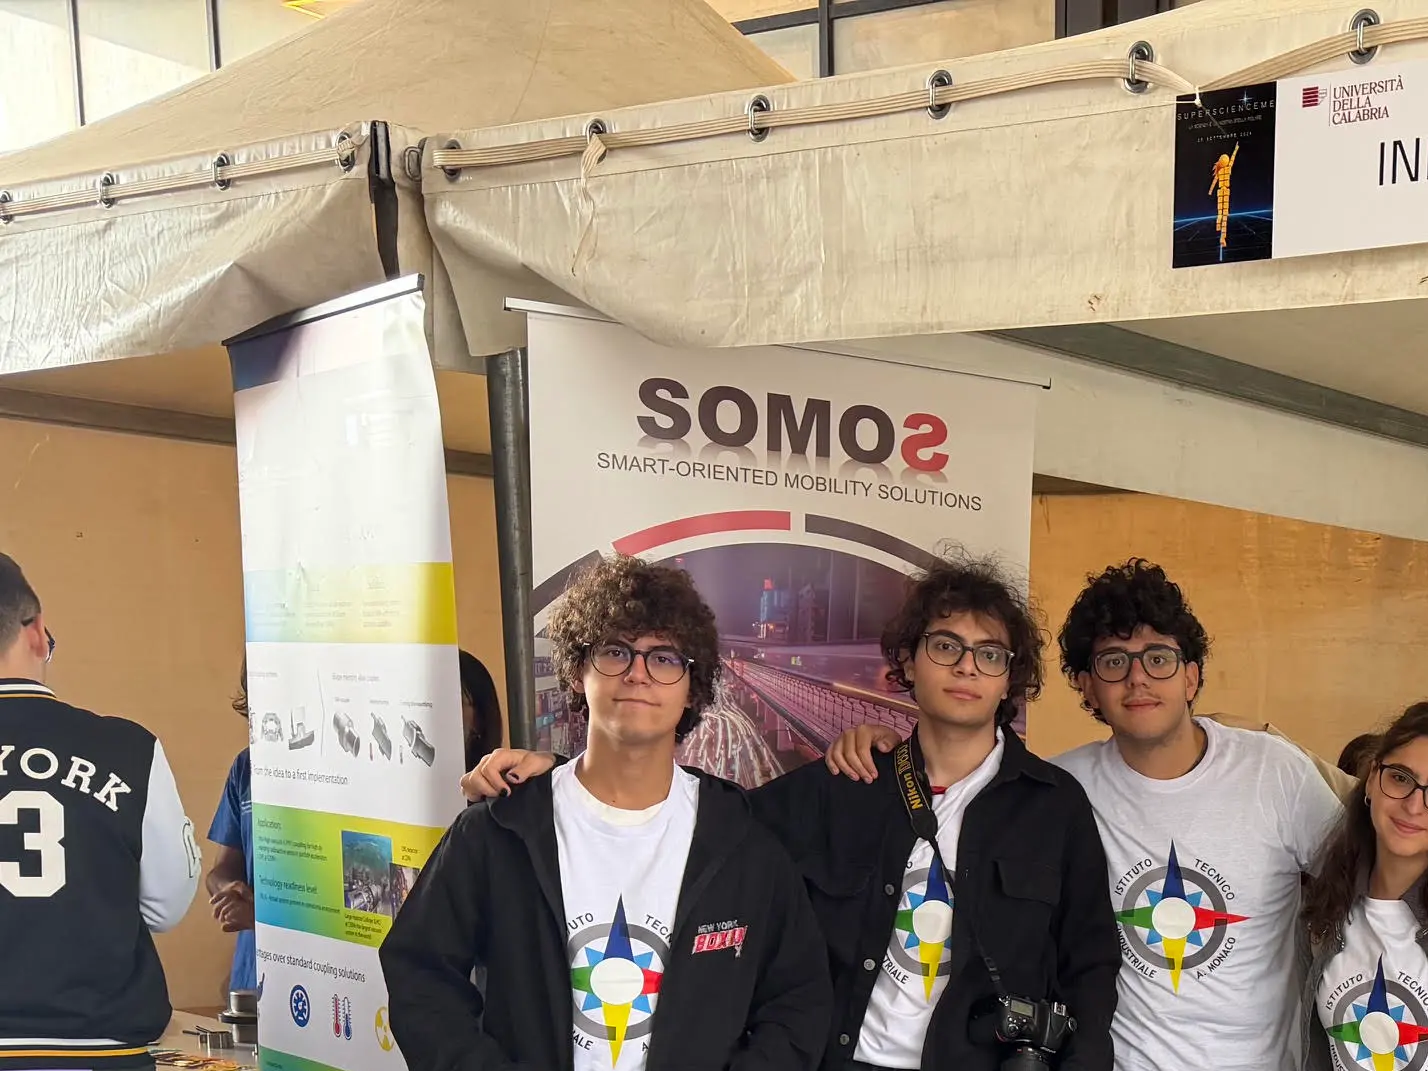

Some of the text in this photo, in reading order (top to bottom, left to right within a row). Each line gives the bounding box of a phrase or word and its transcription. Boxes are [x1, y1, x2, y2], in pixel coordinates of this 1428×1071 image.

[1333, 75, 1404, 99] UNIVERSITÀ
[1177, 100, 1275, 120] SUPERSCIENCEME
[1332, 106, 1389, 125] CALABRIA
[1333, 96, 1372, 112] DELLA
[597, 452, 982, 511] SMART-ORIENTED MOBILITY SOLUTIONS
[0, 745, 132, 812] YORK
[904, 772, 923, 810] Nikon
[1115, 858, 1235, 901] ISTITUTO TECNICO
[716, 919, 738, 931] YORK
[273, 954, 286, 964] over
[287, 954, 313, 970] standard
[313, 961, 338, 979] coupling
[338, 966, 366, 983] solutions
[1209, 937, 1236, 974] MONACO
[883, 956, 909, 985] TRIALE
[1325, 973, 1363, 1011] ISTITUTO
